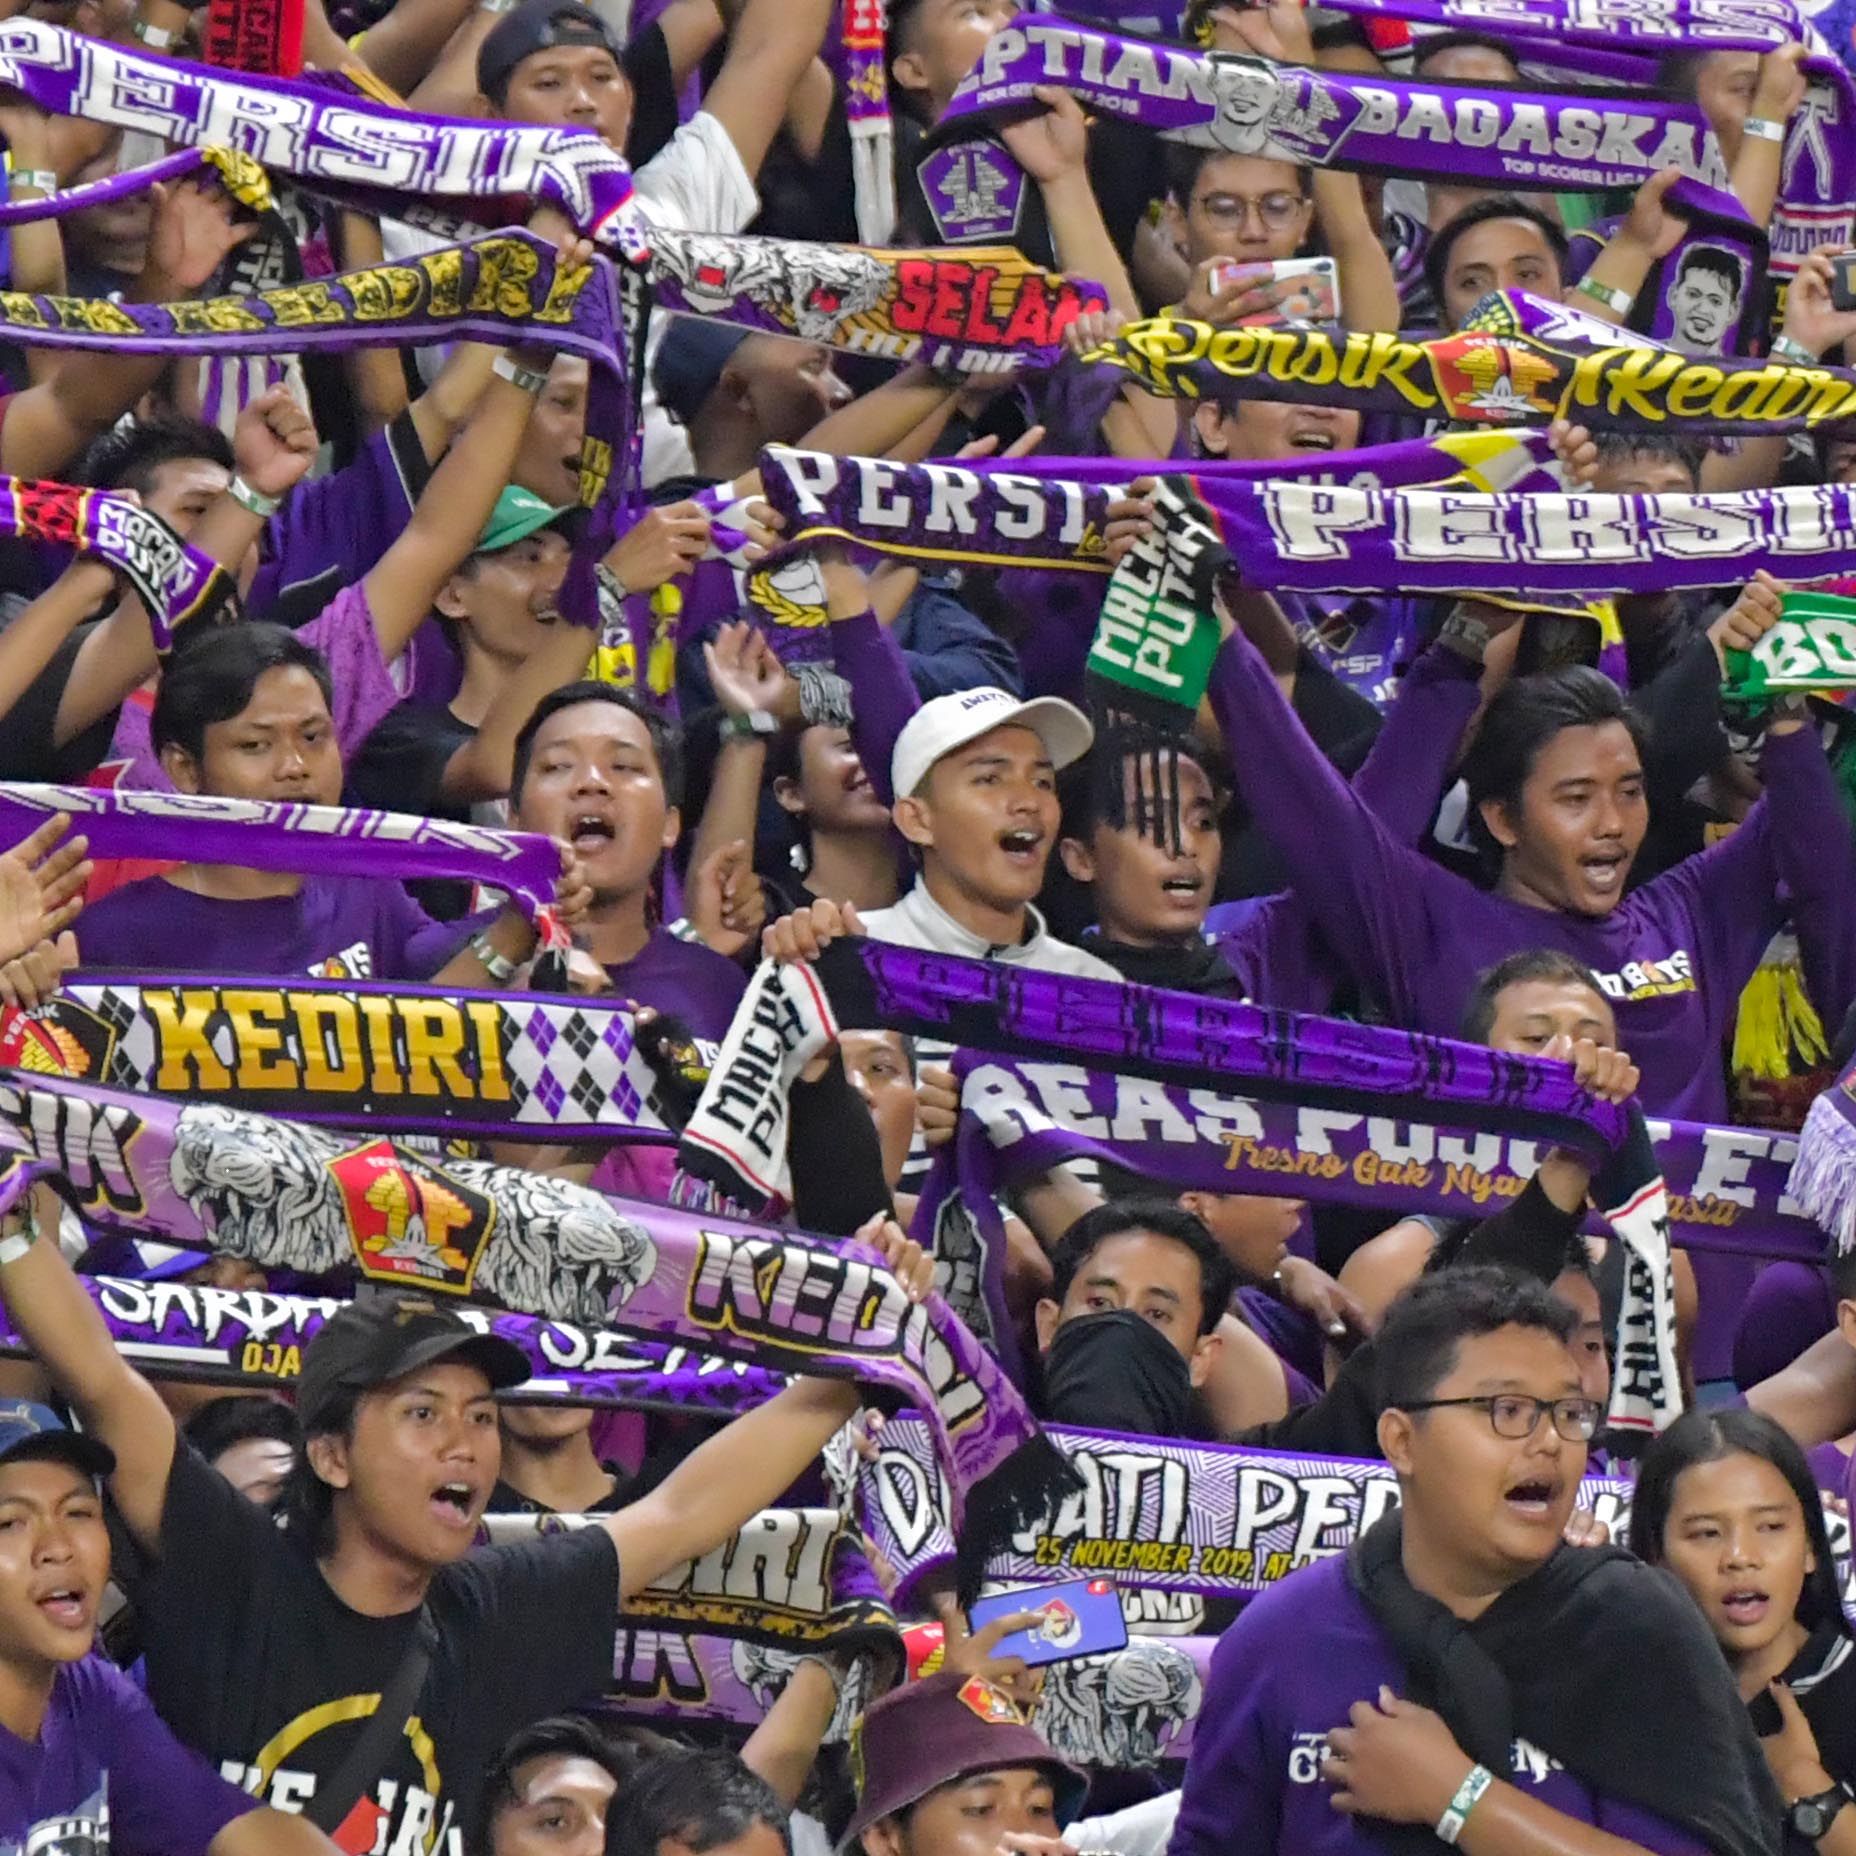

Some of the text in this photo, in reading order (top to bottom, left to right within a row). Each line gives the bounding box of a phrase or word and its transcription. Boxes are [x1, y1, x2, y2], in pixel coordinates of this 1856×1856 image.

[0, 19, 628, 224] PERSIK
[958, 26, 1726, 193] PTIAN BAGASKA
[1143, 315, 1437, 404] Persik
[765, 447, 1125, 538] PERSI
[141, 989, 511, 1100] KEDIRI
[965, 1063, 1264, 1143] REAS
[1223, 1134, 1344, 1177] Tresno
[1036, 1535, 1259, 1576] 25 NOVEMBER 2019,
